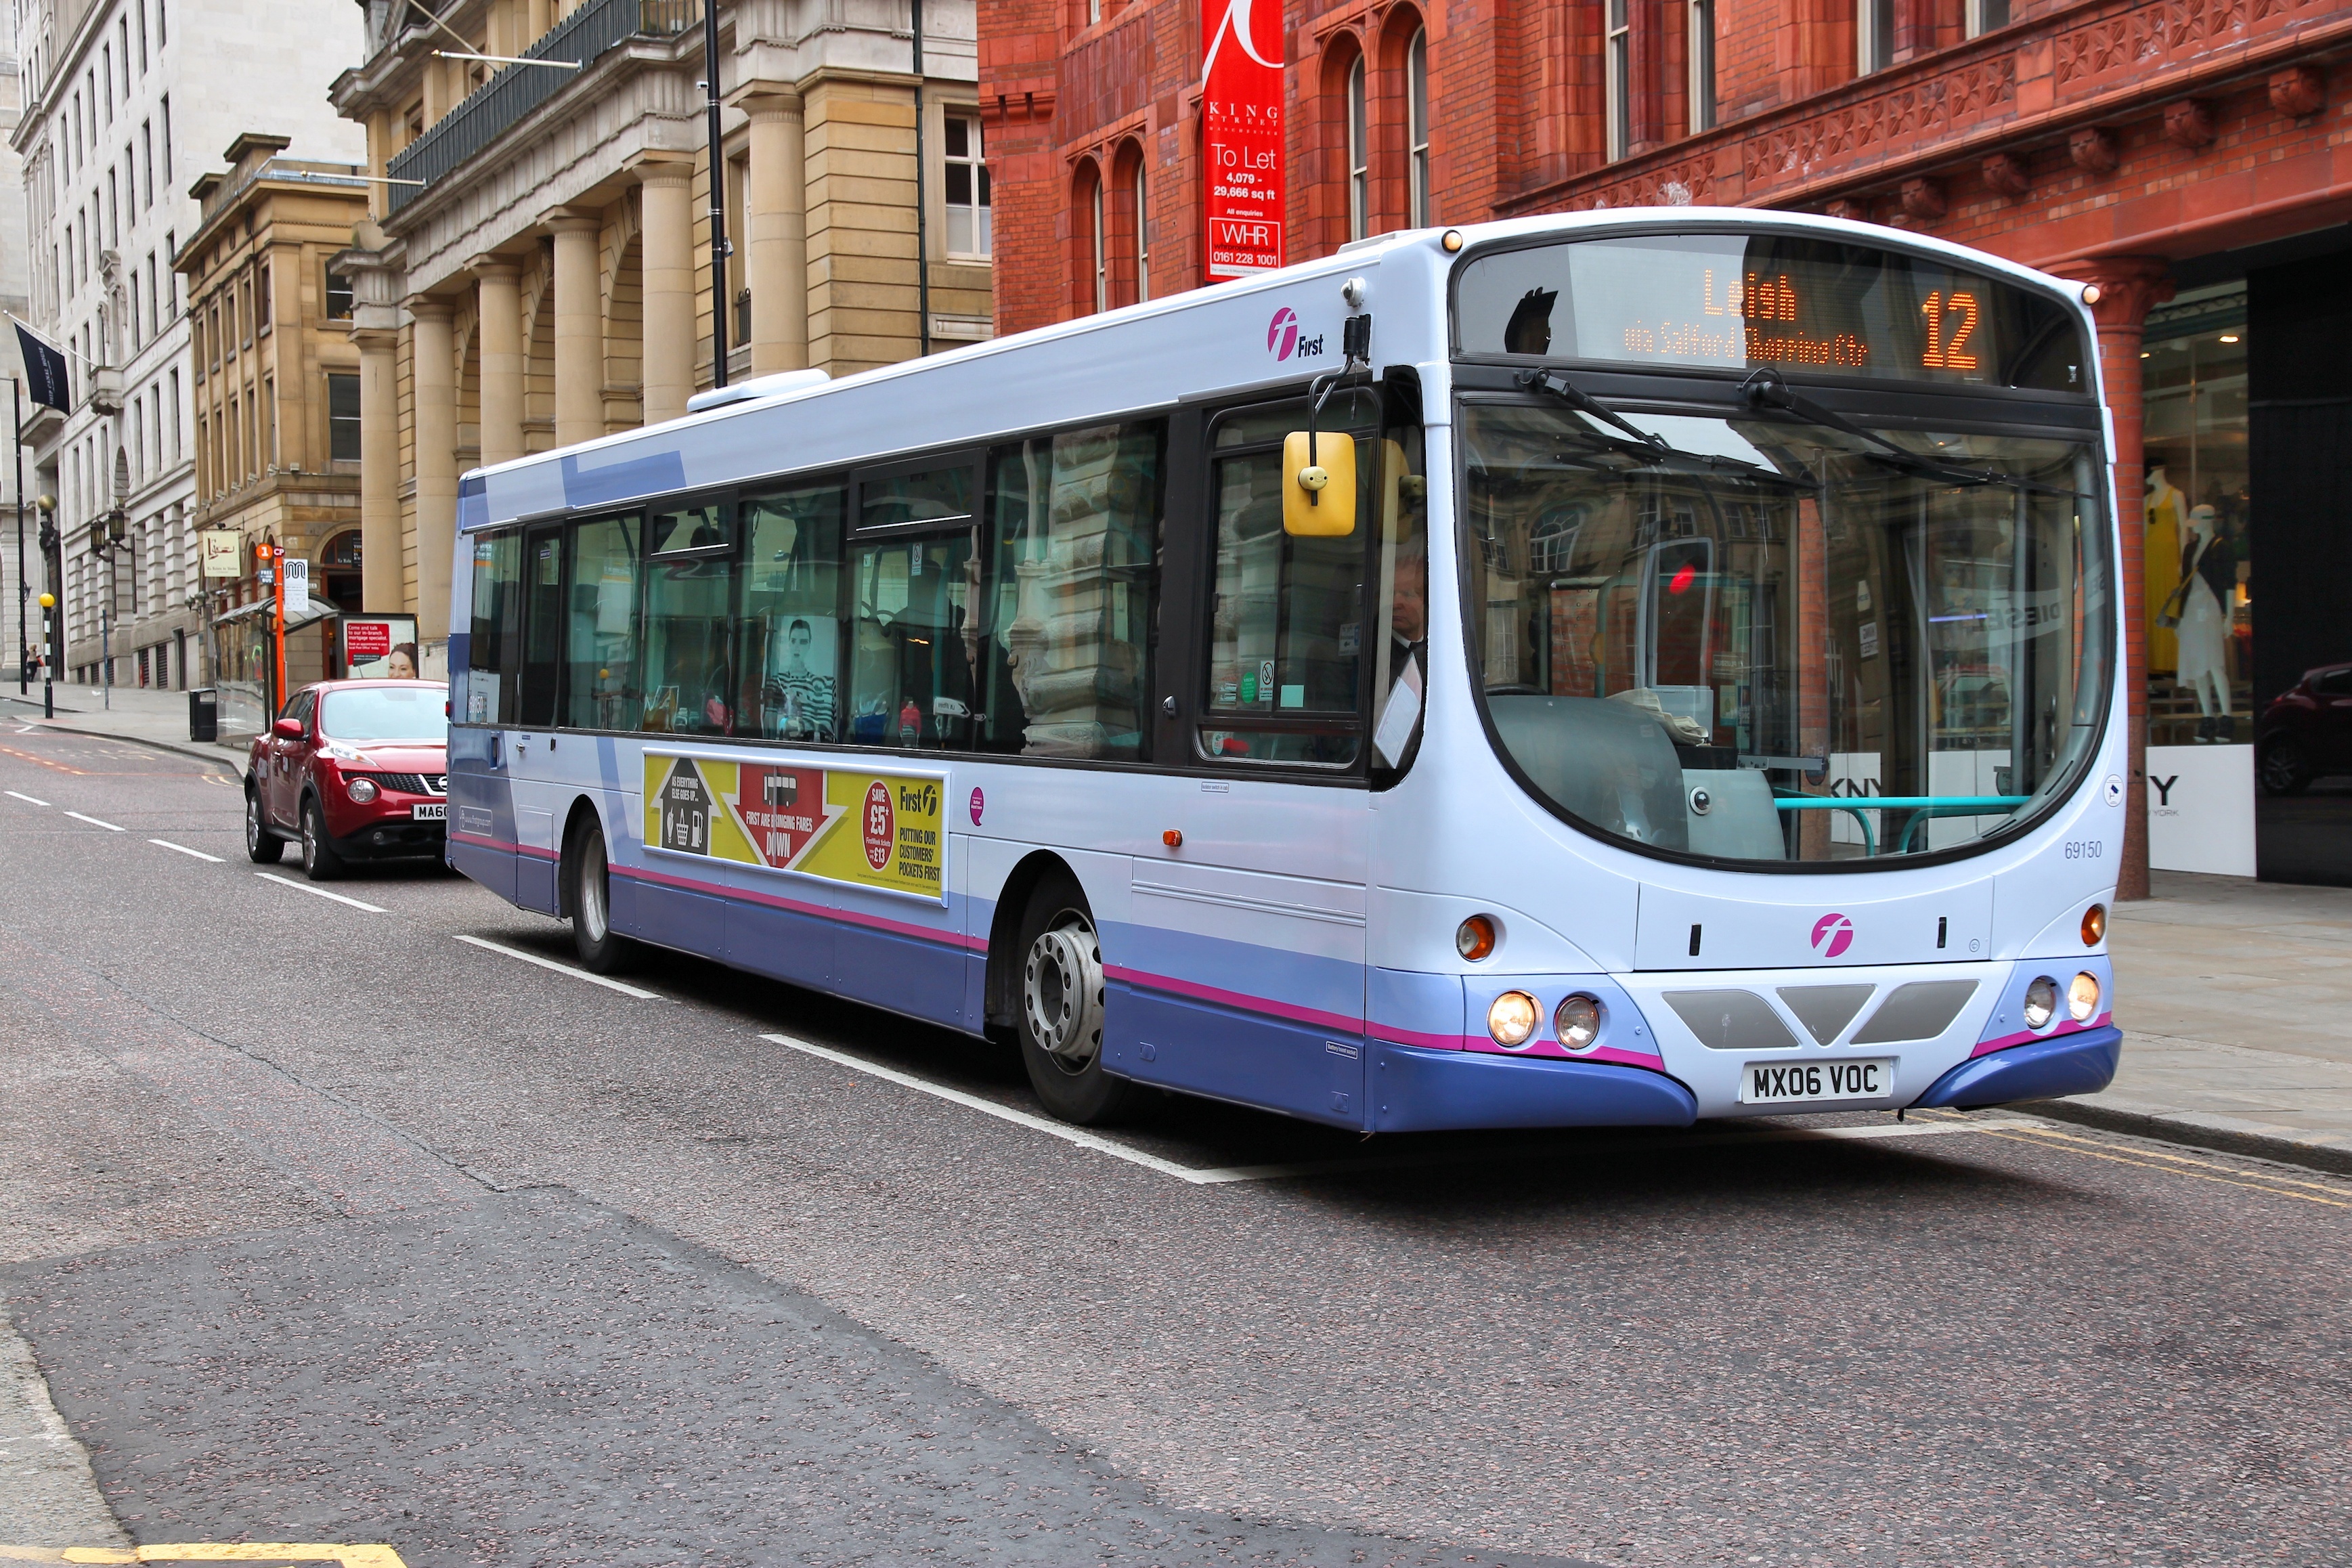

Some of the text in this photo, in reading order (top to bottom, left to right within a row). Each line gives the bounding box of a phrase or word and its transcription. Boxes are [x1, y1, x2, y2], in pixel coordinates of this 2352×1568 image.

[1209, 101, 1278, 119] KING
[1208, 114, 1278, 127] STREET
[1211, 143, 1276, 170] To Let
[1226, 173, 1255, 185] 4,079
[1213, 186, 1276, 201] 29,666 sq ft
[1236, 209, 1263, 217] enquiries
[1221, 223, 1268, 246] WHR
[1213, 251, 1277, 266] 0161 228 1001
[1704, 269, 1978, 370] Leigh 12
[1298, 334, 1324, 357] First
[1625, 320, 1654, 352] via
[1660, 320, 1735, 358] Salford
[1835, 334, 1869, 368] Ctr
[261, 546, 285, 557] 1 CP
[469, 696, 483, 714] 69150
[672, 776, 699, 789] AS EVERYTHING
[672, 789, 680, 799] ELSE
[680, 789, 689, 800] GOES
[871, 788, 886, 803] SAVE
[900, 785, 922, 812] First
[746, 810, 813, 833] FIRST ARE BRINGING FARES
[766, 831, 791, 858] DOWN
[881, 839, 891, 847] tickets
[900, 827, 936, 846] PUTTING OUR
[874, 847, 885, 863] £13
[2064, 840, 2102, 861] 69150
[899, 861, 940, 881] POCKETS FIRST
[1754, 1064, 1879, 1098] MX06 VOC
